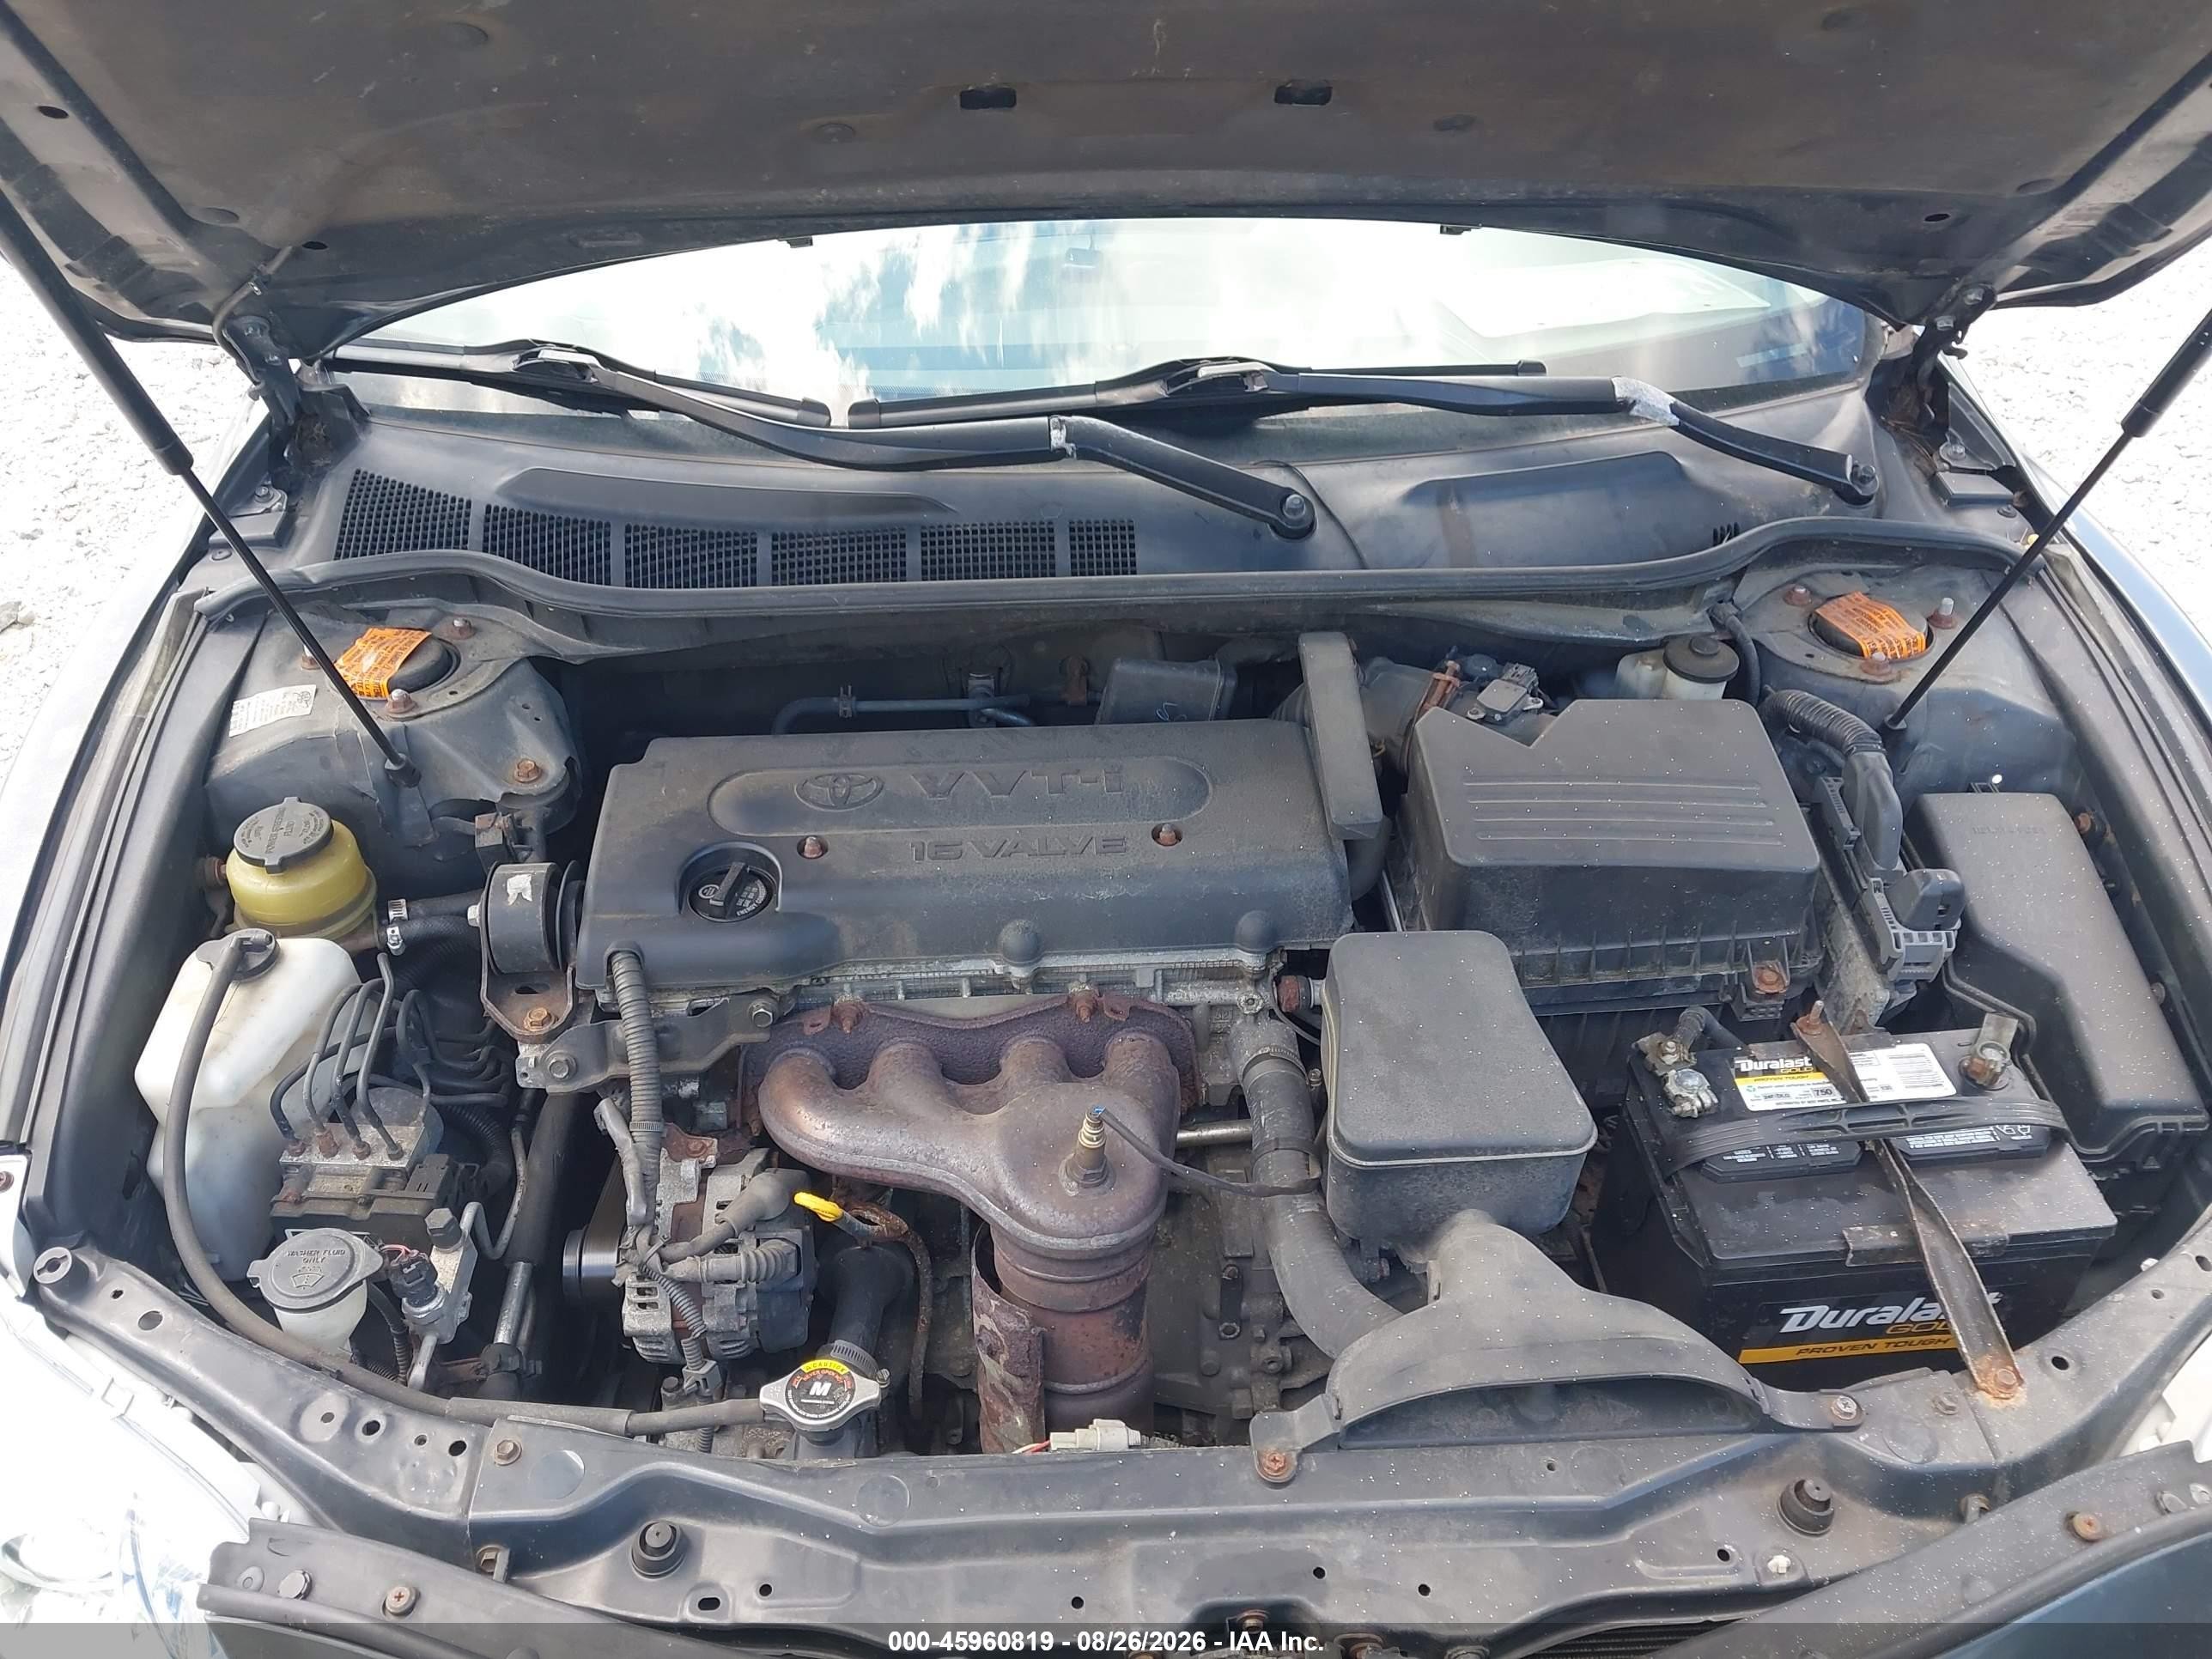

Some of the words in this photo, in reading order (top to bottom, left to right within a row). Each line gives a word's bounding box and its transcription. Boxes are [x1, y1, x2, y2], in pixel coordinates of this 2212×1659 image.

[909, 769, 1123, 800] VVT-i
[910, 840, 963, 862] 16
[968, 836, 1127, 859] VALVE
[1735, 1056, 1813, 1072] Duralast
[1813, 1087, 1833, 1097] 750
[1796, 1343, 1878, 1357] PROVEN
[1883, 1337, 1952, 1350] TOUGH
[812, 1361, 846, 1372] CAUTION
[810, 1382, 832, 1396] M
